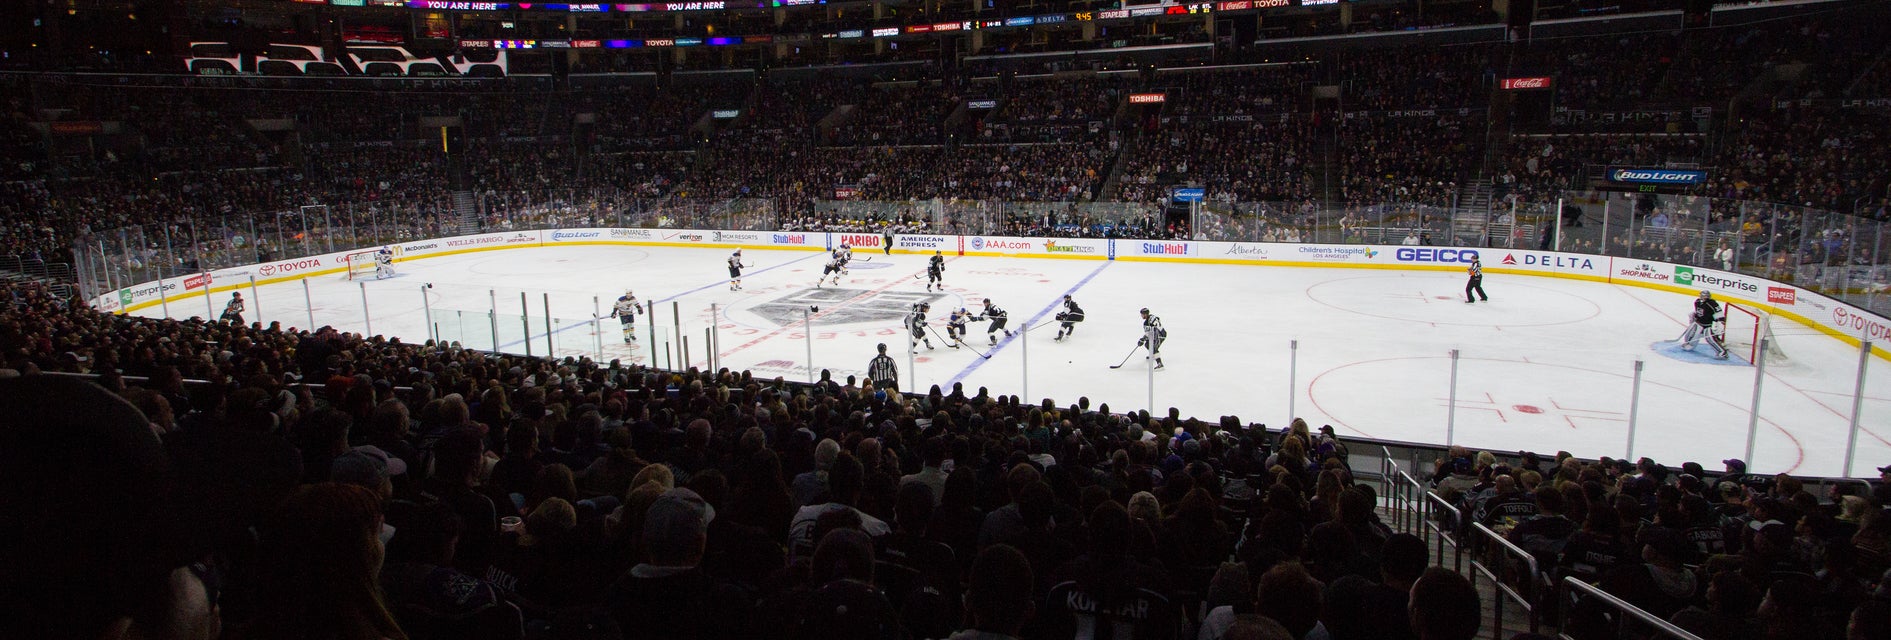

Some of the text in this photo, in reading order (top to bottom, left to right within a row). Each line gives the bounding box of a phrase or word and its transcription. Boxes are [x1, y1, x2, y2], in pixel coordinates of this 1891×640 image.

[427, 1, 497, 11] YOU ARE HERE
[666, 1, 724, 11] YOU ARE HERE
[1254, 0, 1289, 8] TOYOTA
[1043, 15, 1066, 23] DELTA
[1100, 10, 1129, 19] STAPLES
[933, 23, 960, 31] TOSHIBA
[1513, 78, 1543, 88] Coca-Cola
[1130, 95, 1165, 103] TOSHIBA
[1620, 171, 1697, 181] BUD LIGHT
[1639, 184, 1657, 192] EXIT
[610, 228, 651, 237] SAN MANUEL
[679, 233, 703, 241] verizon
[446, 236, 504, 248] WELLS FARGO
[773, 233, 805, 244] StubHub!
[841, 234, 879, 247] HARIBO
[405, 243, 438, 252] McDonald's
[985, 240, 1031, 250] AAA.com
[1143, 242, 1188, 255] StubHub!
[1225, 243, 1268, 255] Alberta
[1298, 246, 1365, 257] Children's Hospital
[1396, 248, 1479, 263] GEICO
[278, 258, 321, 273] TOYOTA
[1524, 254, 1593, 270] DELTA
[1620, 268, 1669, 282] SHOP.NHL.COM
[1675, 270, 1758, 293] enterprise
[122, 282, 176, 300] enterprse
[1768, 289, 1795, 301] STAPLES
[1850, 313, 1891, 343] TOYOTA
[1504, 504, 1533, 514] TOFFOLI
[487, 564, 519, 593] QUICK
